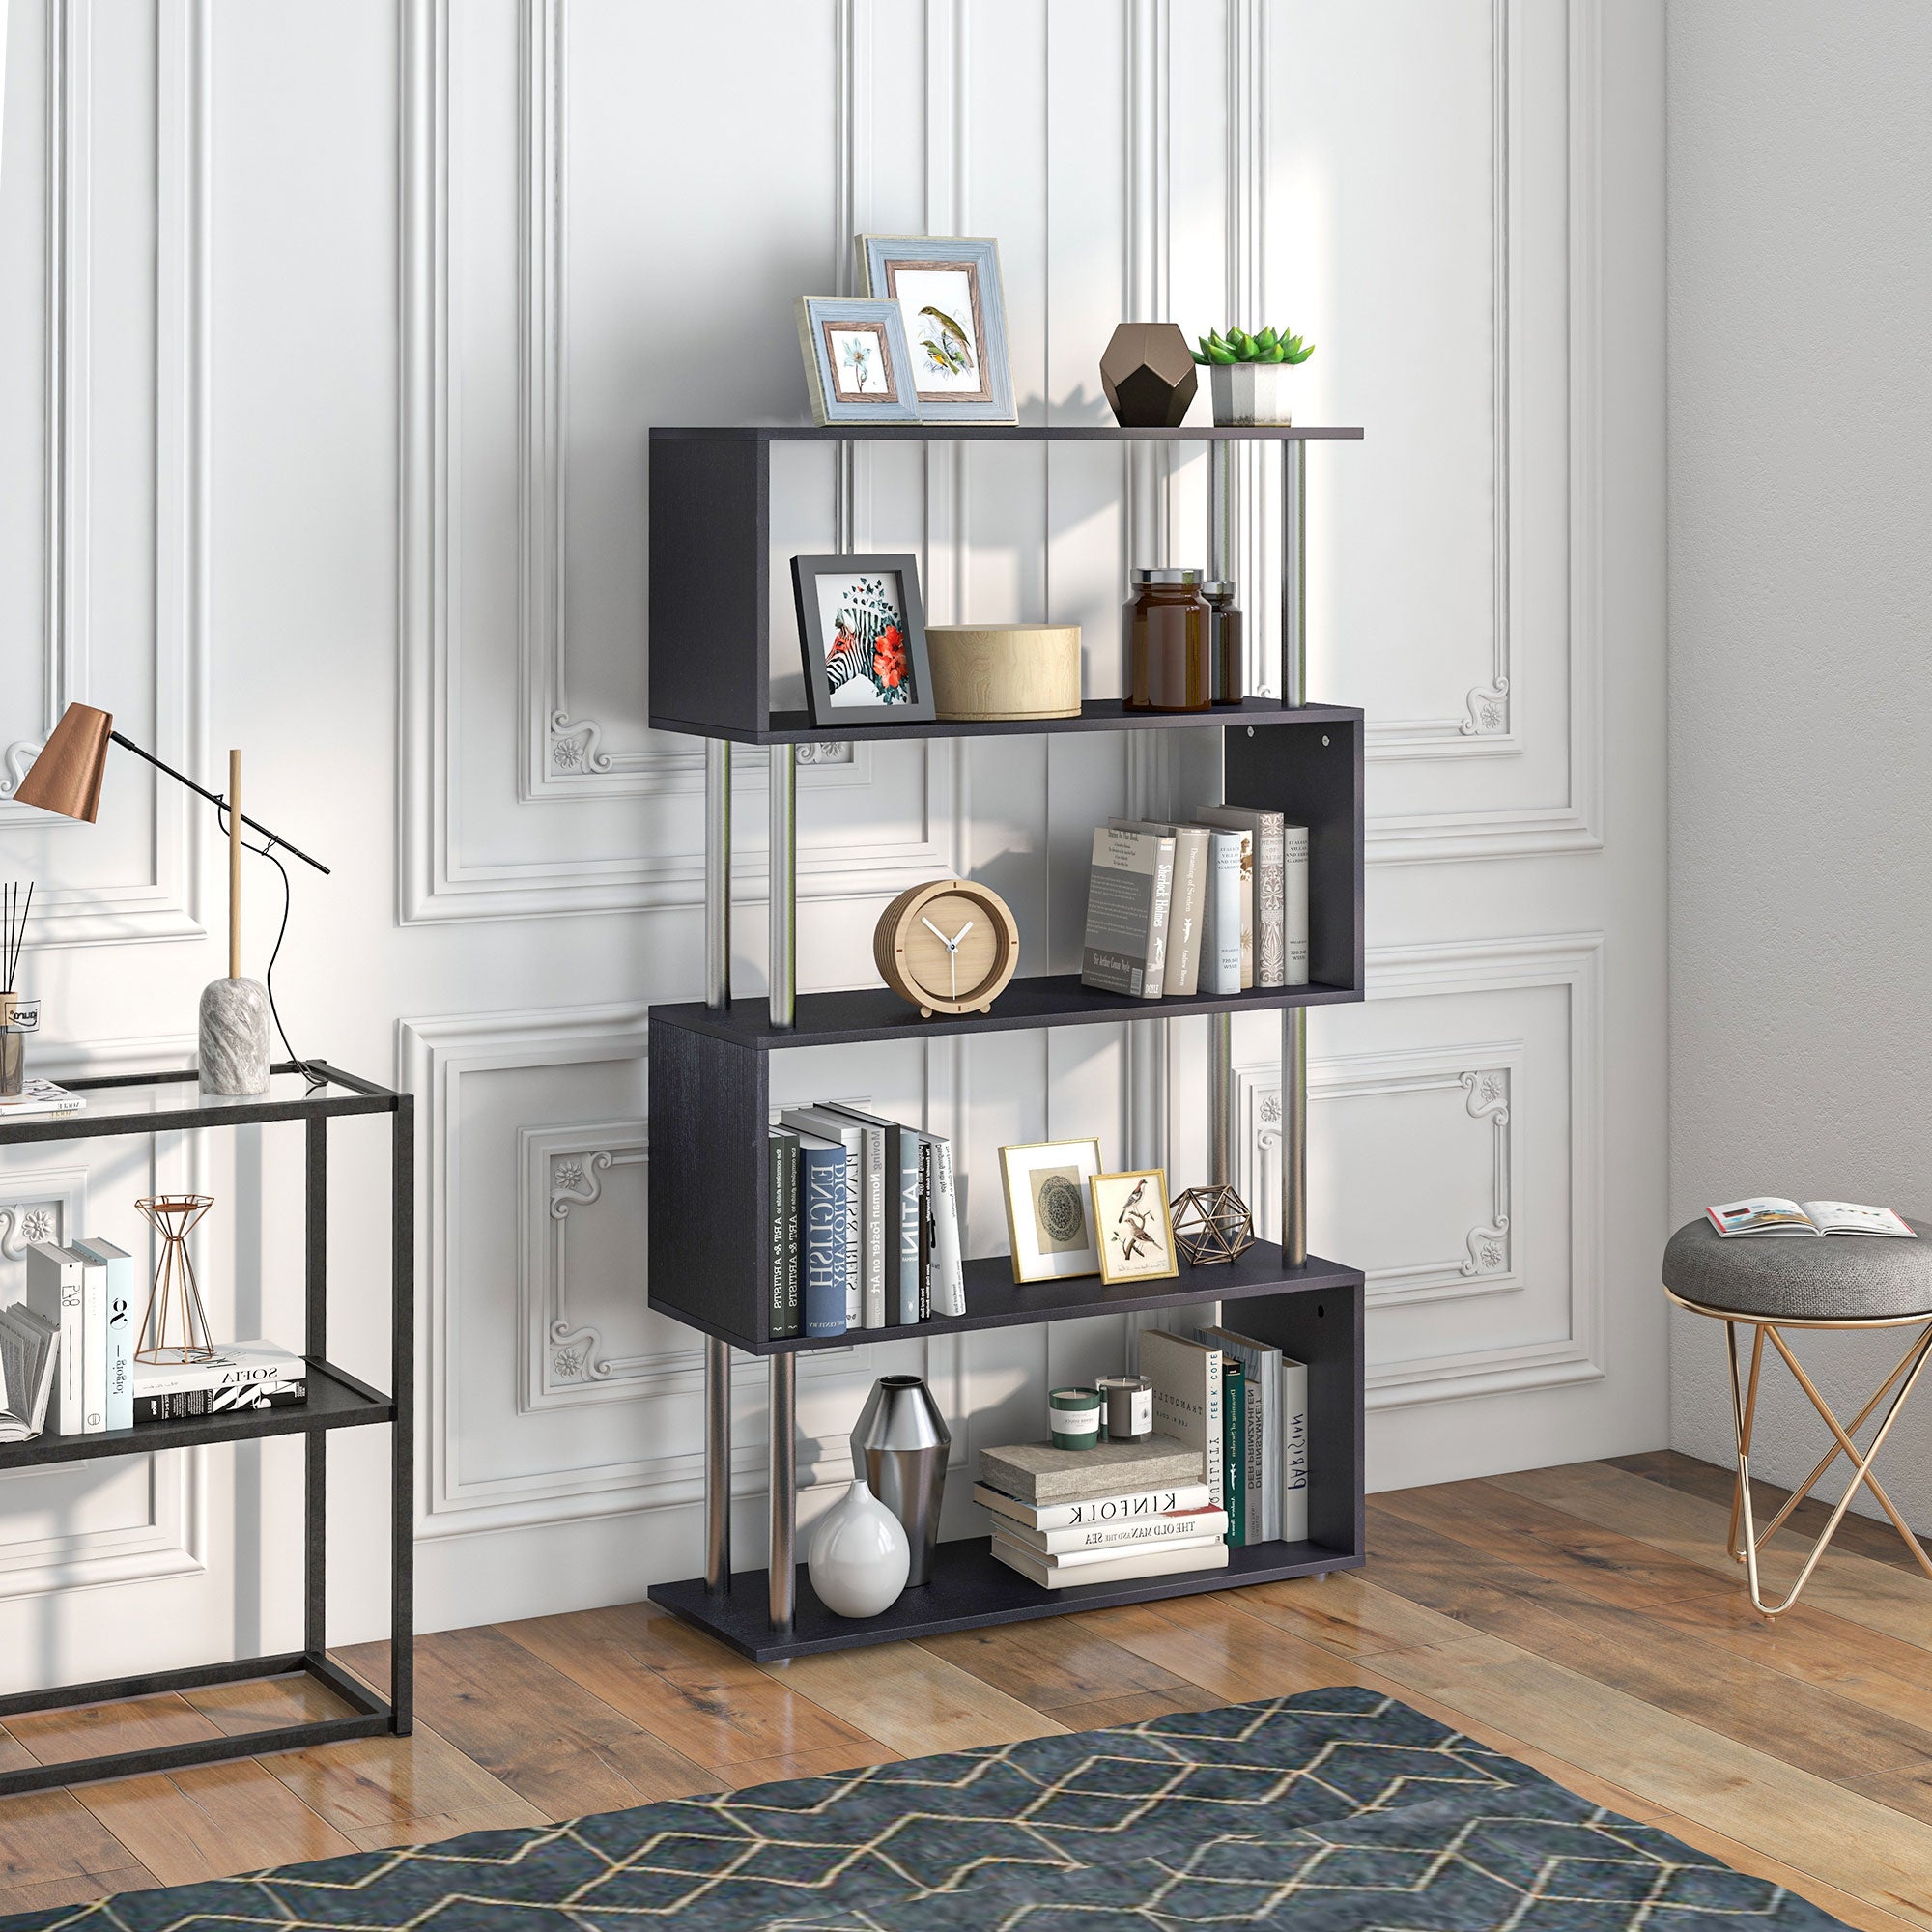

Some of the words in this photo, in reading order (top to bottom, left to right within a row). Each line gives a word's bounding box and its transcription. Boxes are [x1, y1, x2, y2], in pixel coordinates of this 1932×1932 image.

[1186, 847, 1199, 878] Dreaming
[1156, 864, 1172, 897] Sherlock
[1153, 899, 1169, 927] Holmes
[1185, 887, 1195, 912] Sweden
